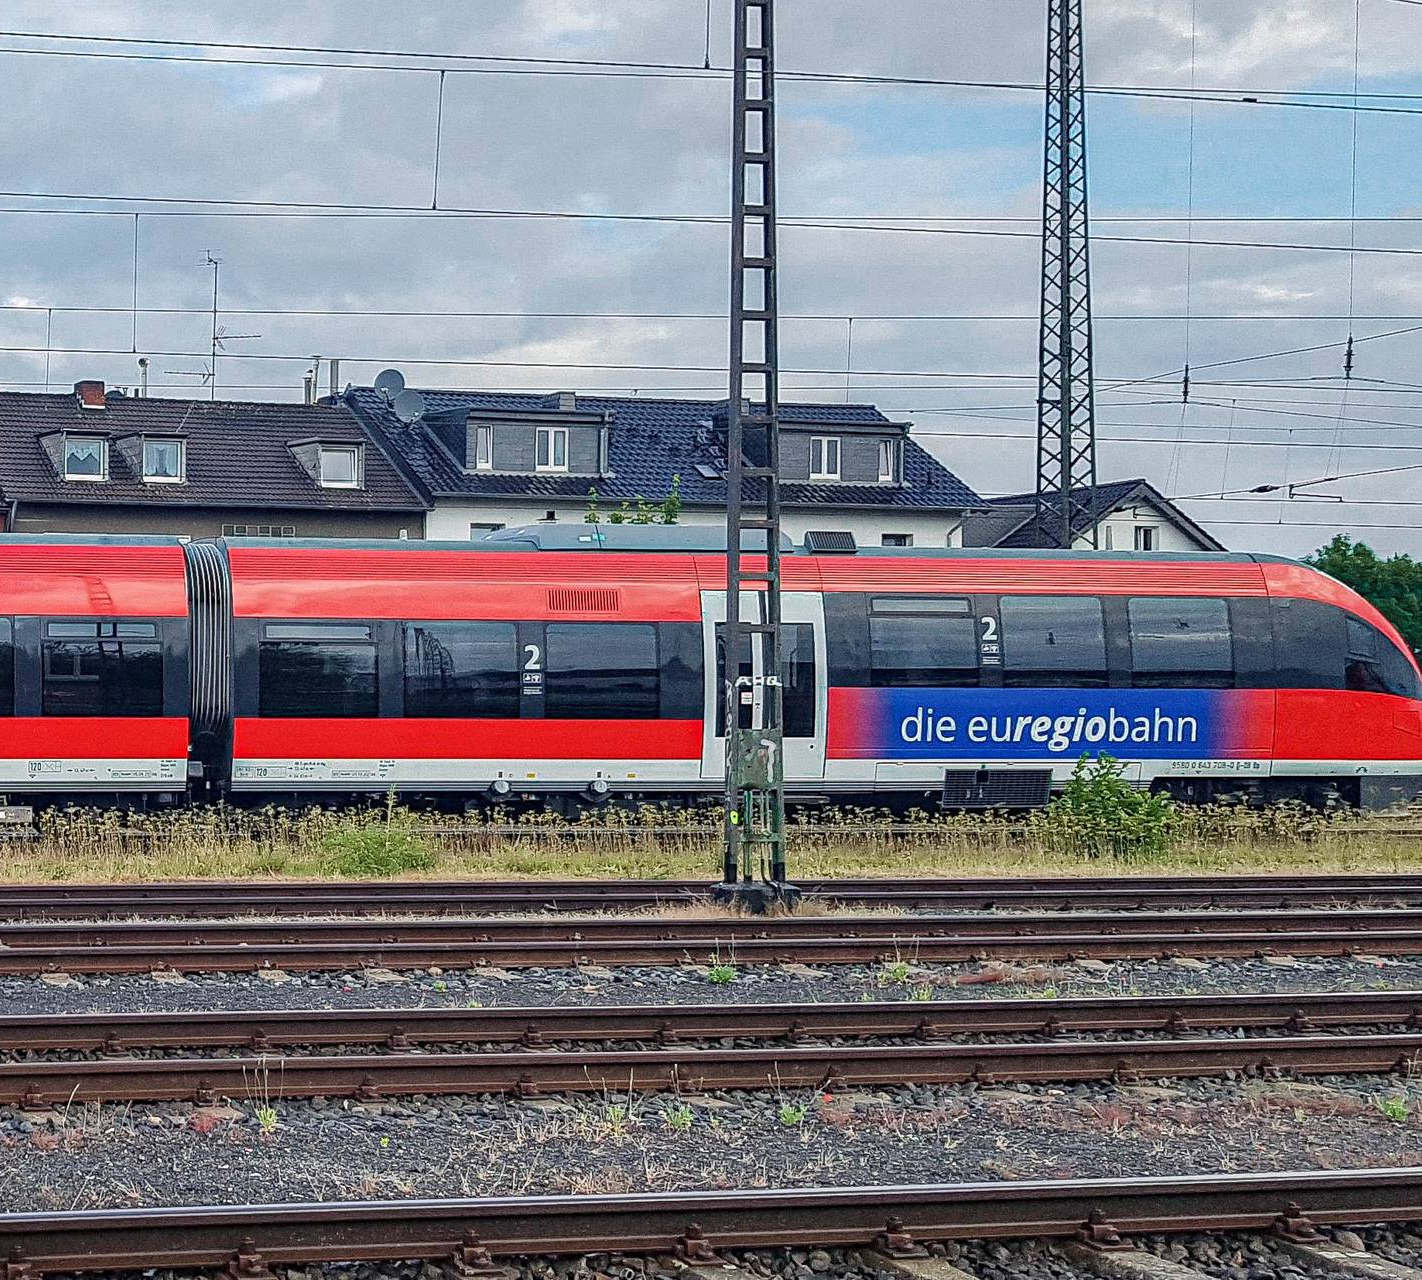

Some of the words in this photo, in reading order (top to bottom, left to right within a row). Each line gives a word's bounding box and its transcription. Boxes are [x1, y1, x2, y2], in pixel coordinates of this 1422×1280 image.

[981, 616, 998, 640] 2
[524, 644, 540, 670] 2
[900, 706, 957, 743] die
[967, 707, 1198, 752] euregiobahn
[30, 762, 42, 771] 120
[256, 768, 268, 777] 120
